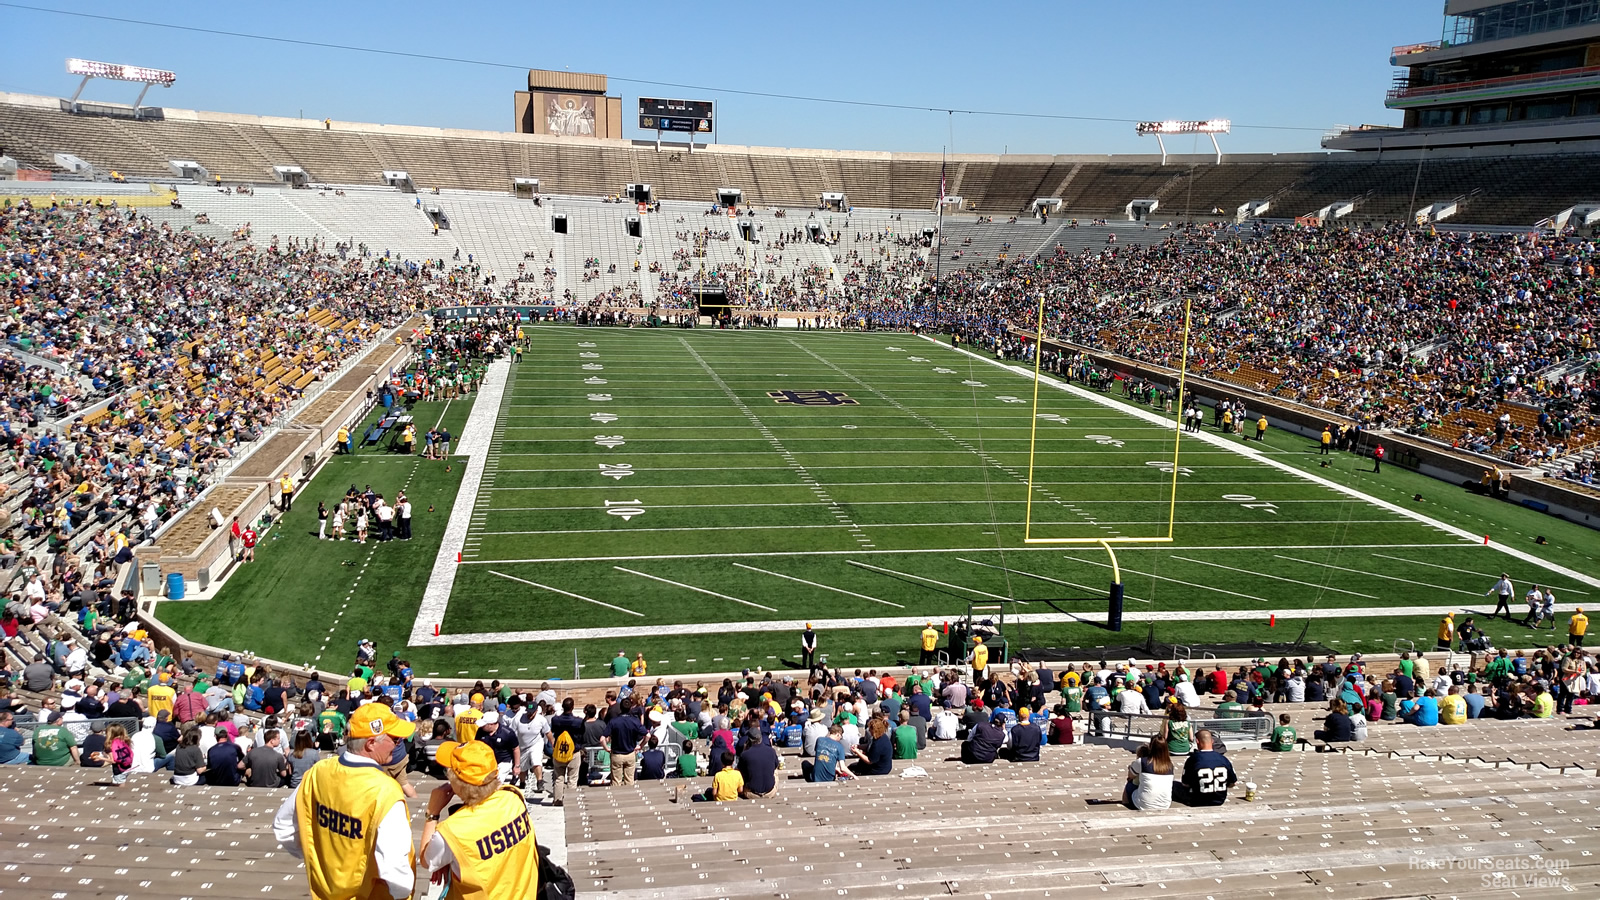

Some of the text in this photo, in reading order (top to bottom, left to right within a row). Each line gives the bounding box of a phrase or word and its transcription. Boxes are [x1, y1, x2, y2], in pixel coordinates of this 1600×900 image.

[594, 435, 625, 446] 30
[598, 464, 634, 476] 20
[604, 498, 646, 516] 10
[1222, 494, 1279, 509] 10
[431, 707, 440, 720] 5
[1198, 766, 1228, 794] 22
